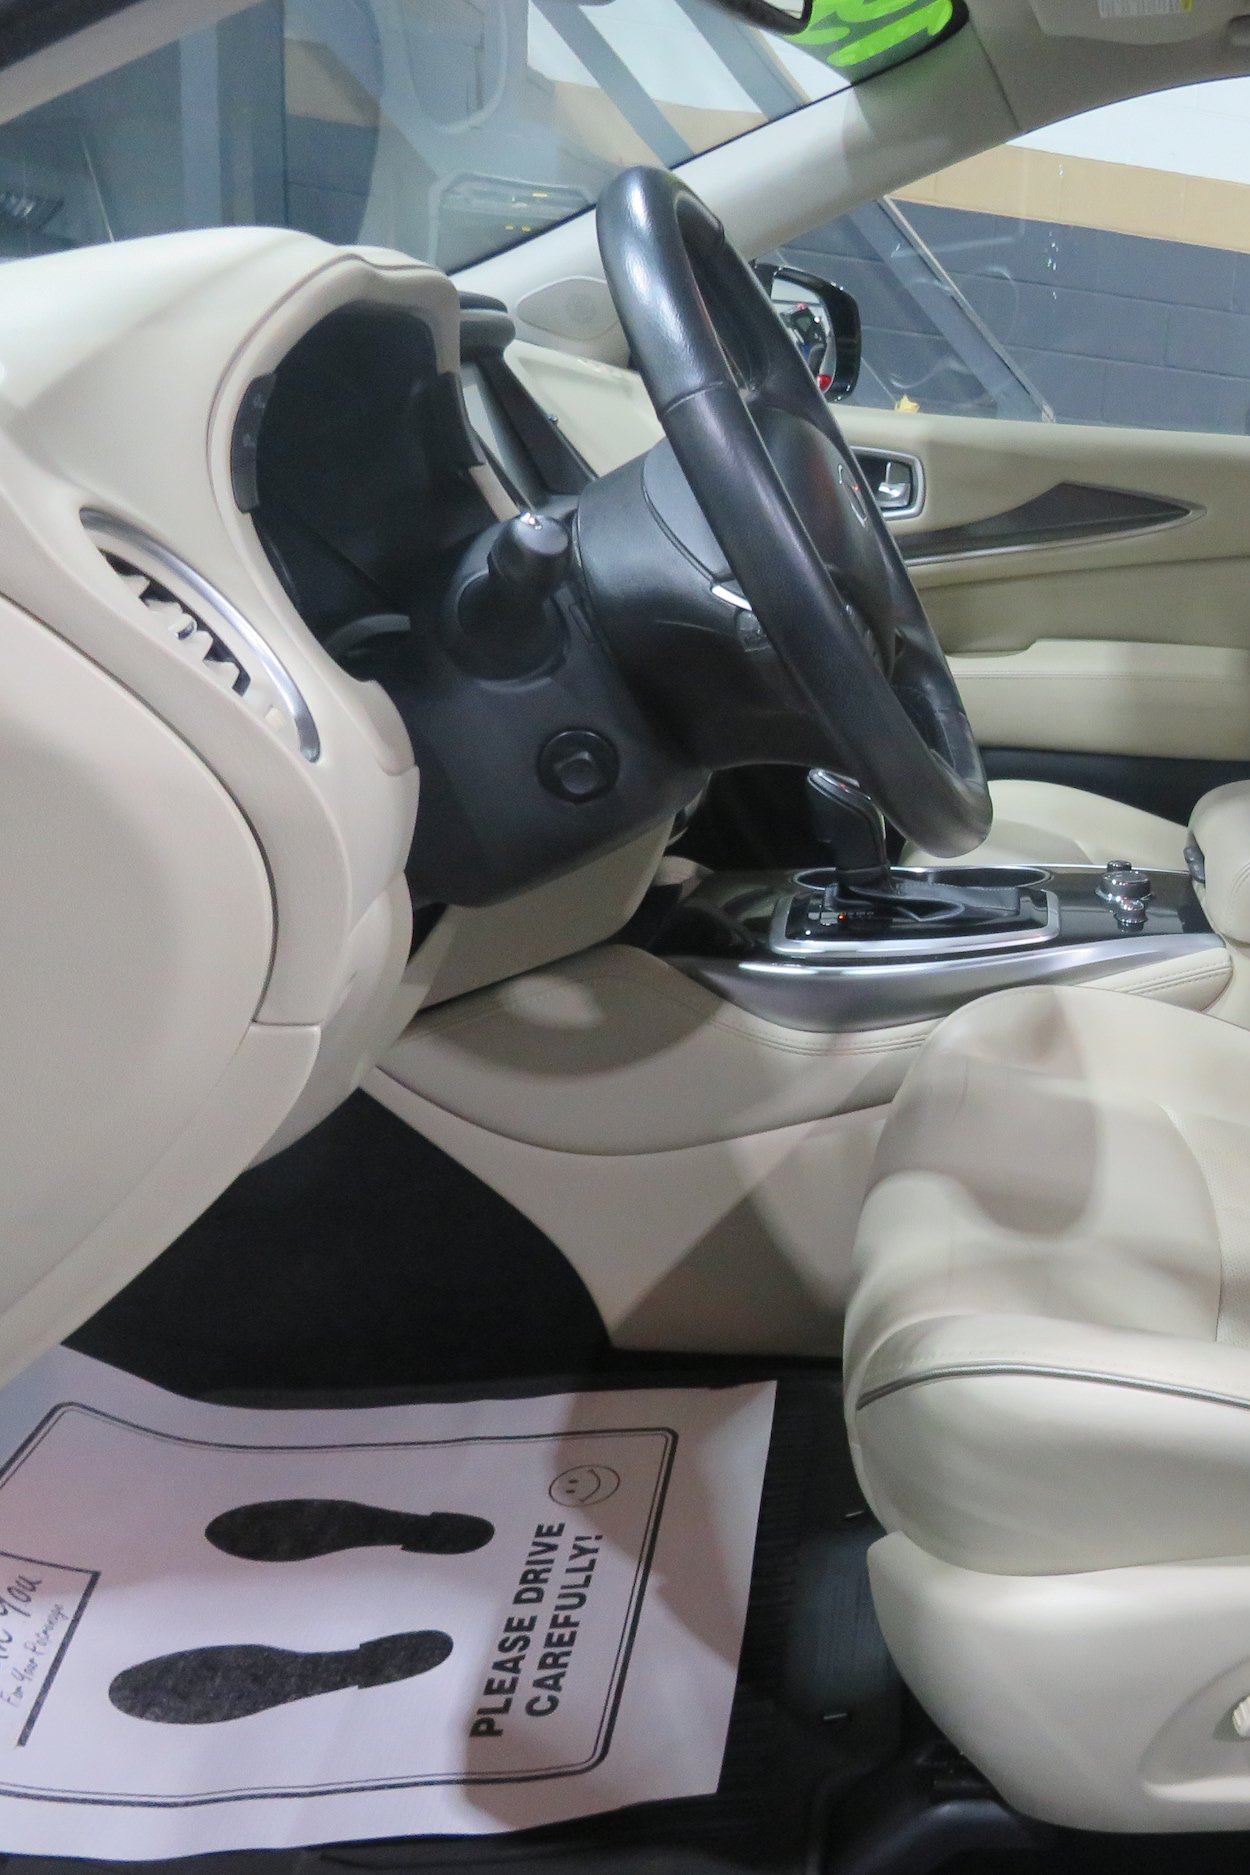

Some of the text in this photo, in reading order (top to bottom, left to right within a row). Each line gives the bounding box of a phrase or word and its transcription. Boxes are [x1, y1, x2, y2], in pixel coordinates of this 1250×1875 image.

[469, 1522, 567, 1738] PLEASE DRIVE
[525, 1534, 604, 1718] CAREFULLY!
